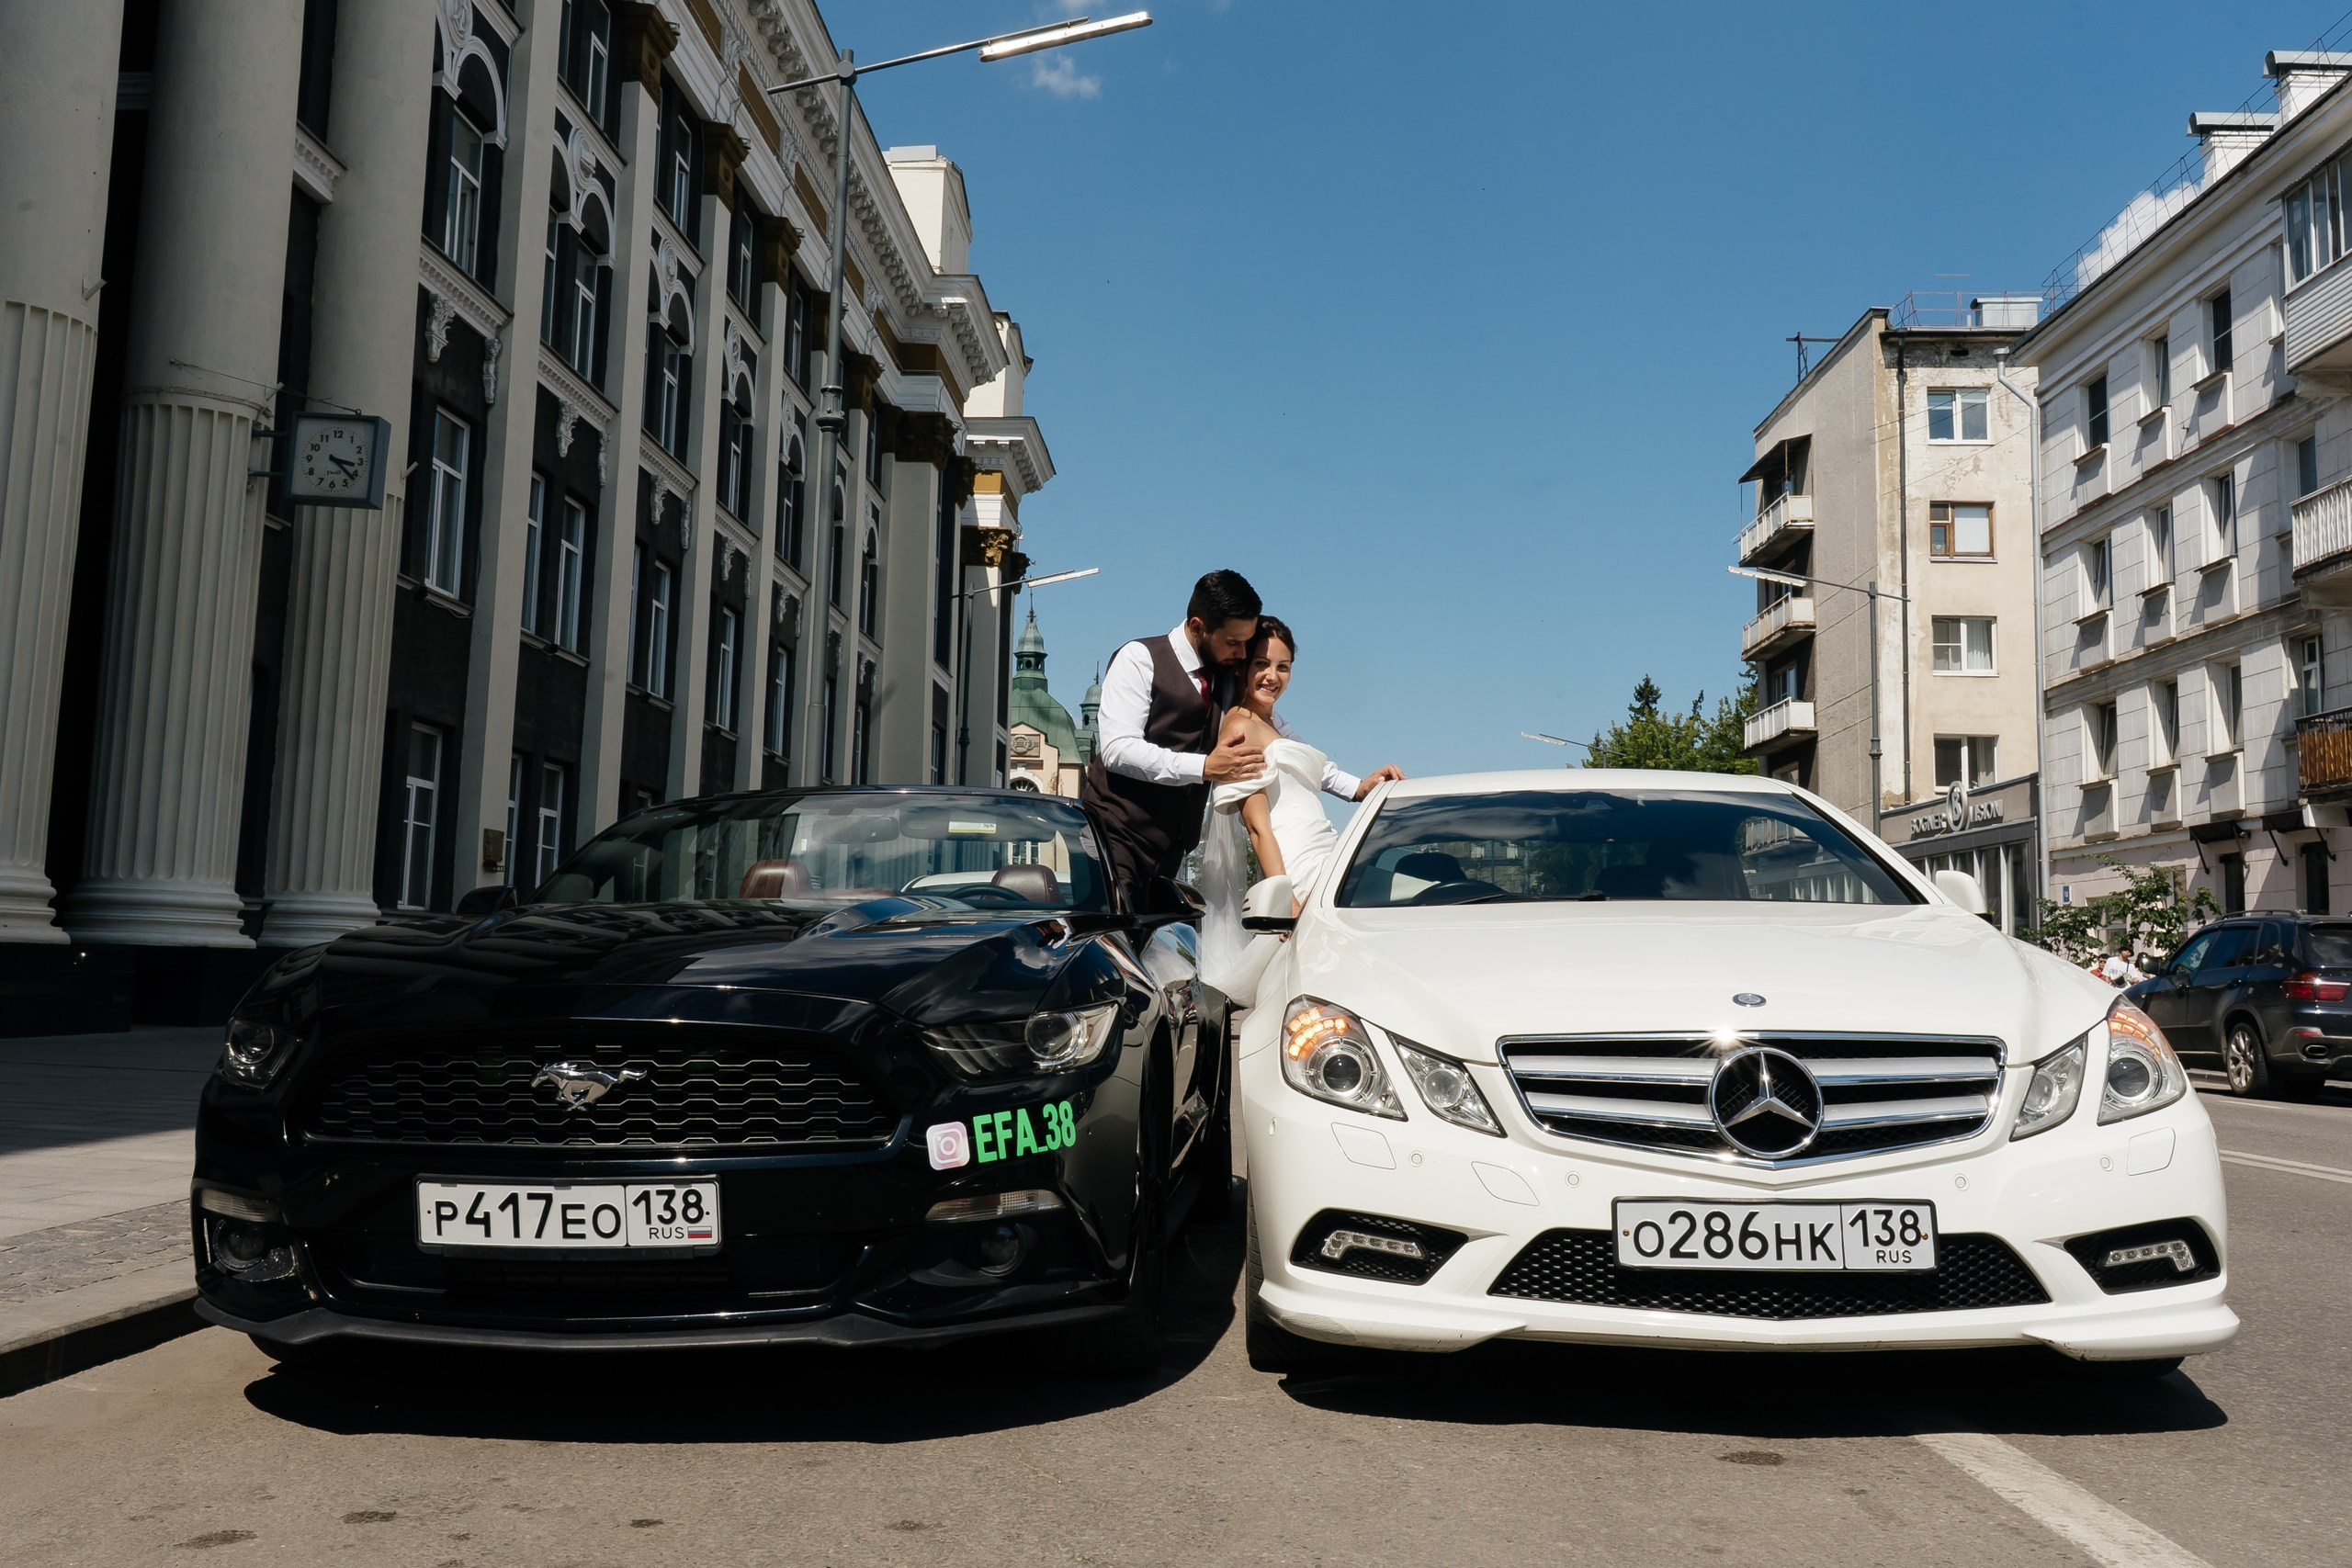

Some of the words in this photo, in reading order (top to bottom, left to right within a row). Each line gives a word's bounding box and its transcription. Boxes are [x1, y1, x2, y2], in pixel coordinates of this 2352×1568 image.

[320, 434, 330, 443] 11
[334, 430, 344, 439] 12
[311, 444, 321, 452] 10
[356, 446, 363, 455] 2
[306, 455, 313, 463] 9
[356, 457, 364, 467] 3
[308, 468, 314, 476] 8
[317, 478, 324, 486] 7
[328, 480, 335, 489] 6
[342, 479, 348, 487] 5
[631, 1189, 705, 1225] 138
[649, 1225, 684, 1240] RUS
[1848, 1209, 1922, 1247] 138
[1876, 1249, 1912, 1264] RUS
